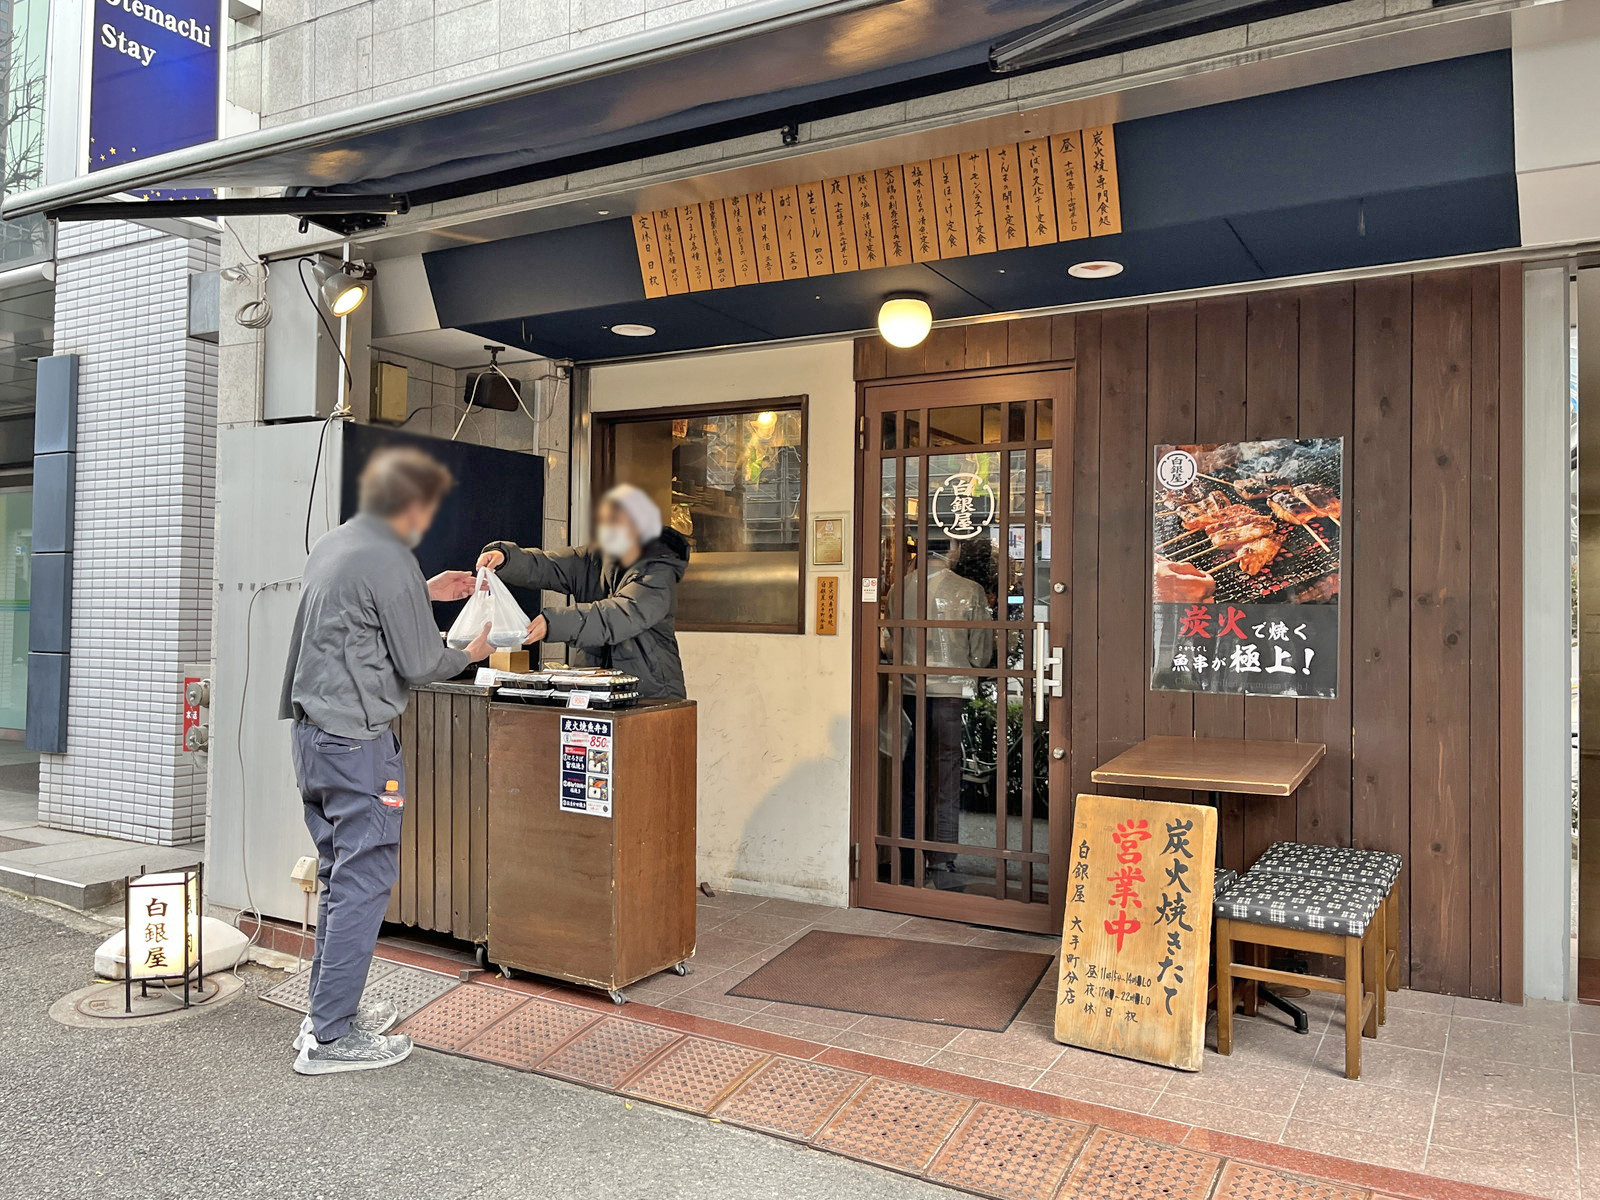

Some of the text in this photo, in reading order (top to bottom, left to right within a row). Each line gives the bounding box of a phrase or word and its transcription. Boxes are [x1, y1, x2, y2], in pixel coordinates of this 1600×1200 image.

[101, 23, 157, 67] Stay
[105, 0, 212, 48] temachi
[1059, 137, 1076, 154] 昼
[830, 179, 844, 195] 夜
[997, 149, 1016, 240] さんまの開き定食
[1028, 144, 1048, 236] さばの文化干し定食
[1091, 130, 1111, 227] 炭火焼専門食処
[755, 192, 767, 217] 焼酎
[779, 193, 793, 241] 酎ハイ
[807, 189, 821, 239] 生ビール
[942, 161, 958, 248] しまほっけ定食
[638, 216, 652, 253] 定休日
[684, 205, 700, 261] おつまみ各種
[760, 223, 771, 251] 日本酒
[1170, 456, 1184, 483] 白銀屋
[950, 479, 977, 531] 白銀屋
[1178, 604, 1308, 642] 炭火で焼く
[1172, 643, 1316, 676] 魚串が極上!
[564, 719, 608, 734] 炭火焼魚弁当
[1104, 819, 1152, 953] 営業中
[144, 897, 169, 969] 白銀屋
[1060, 840, 1091, 1006] 白銀屋 大手町分店
[1153, 818, 1194, 1015] 炭火焼きたて
